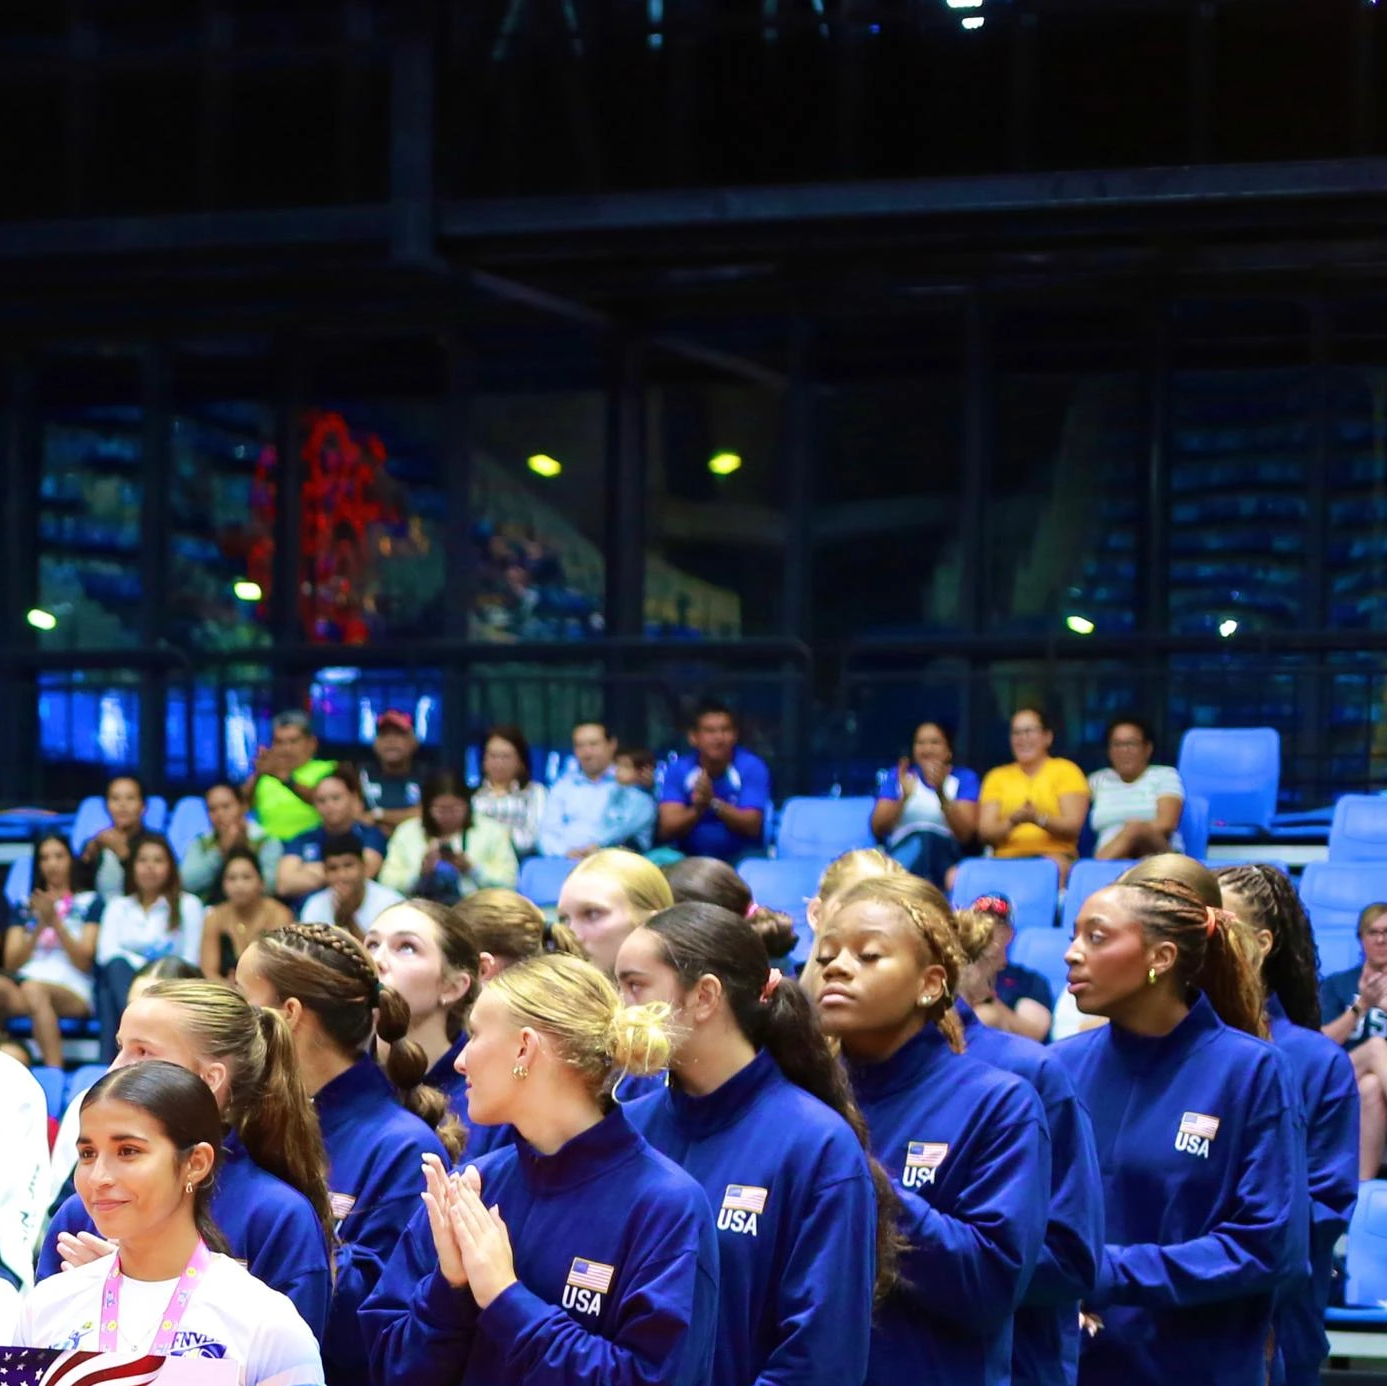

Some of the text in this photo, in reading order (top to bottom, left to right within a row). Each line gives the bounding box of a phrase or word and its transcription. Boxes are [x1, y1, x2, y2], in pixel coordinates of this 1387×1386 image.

[1175, 1131, 1209, 1158] USA
[902, 1166, 936, 1188] USA
[717, 1208, 757, 1237] USA
[562, 1284, 601, 1317] USA
